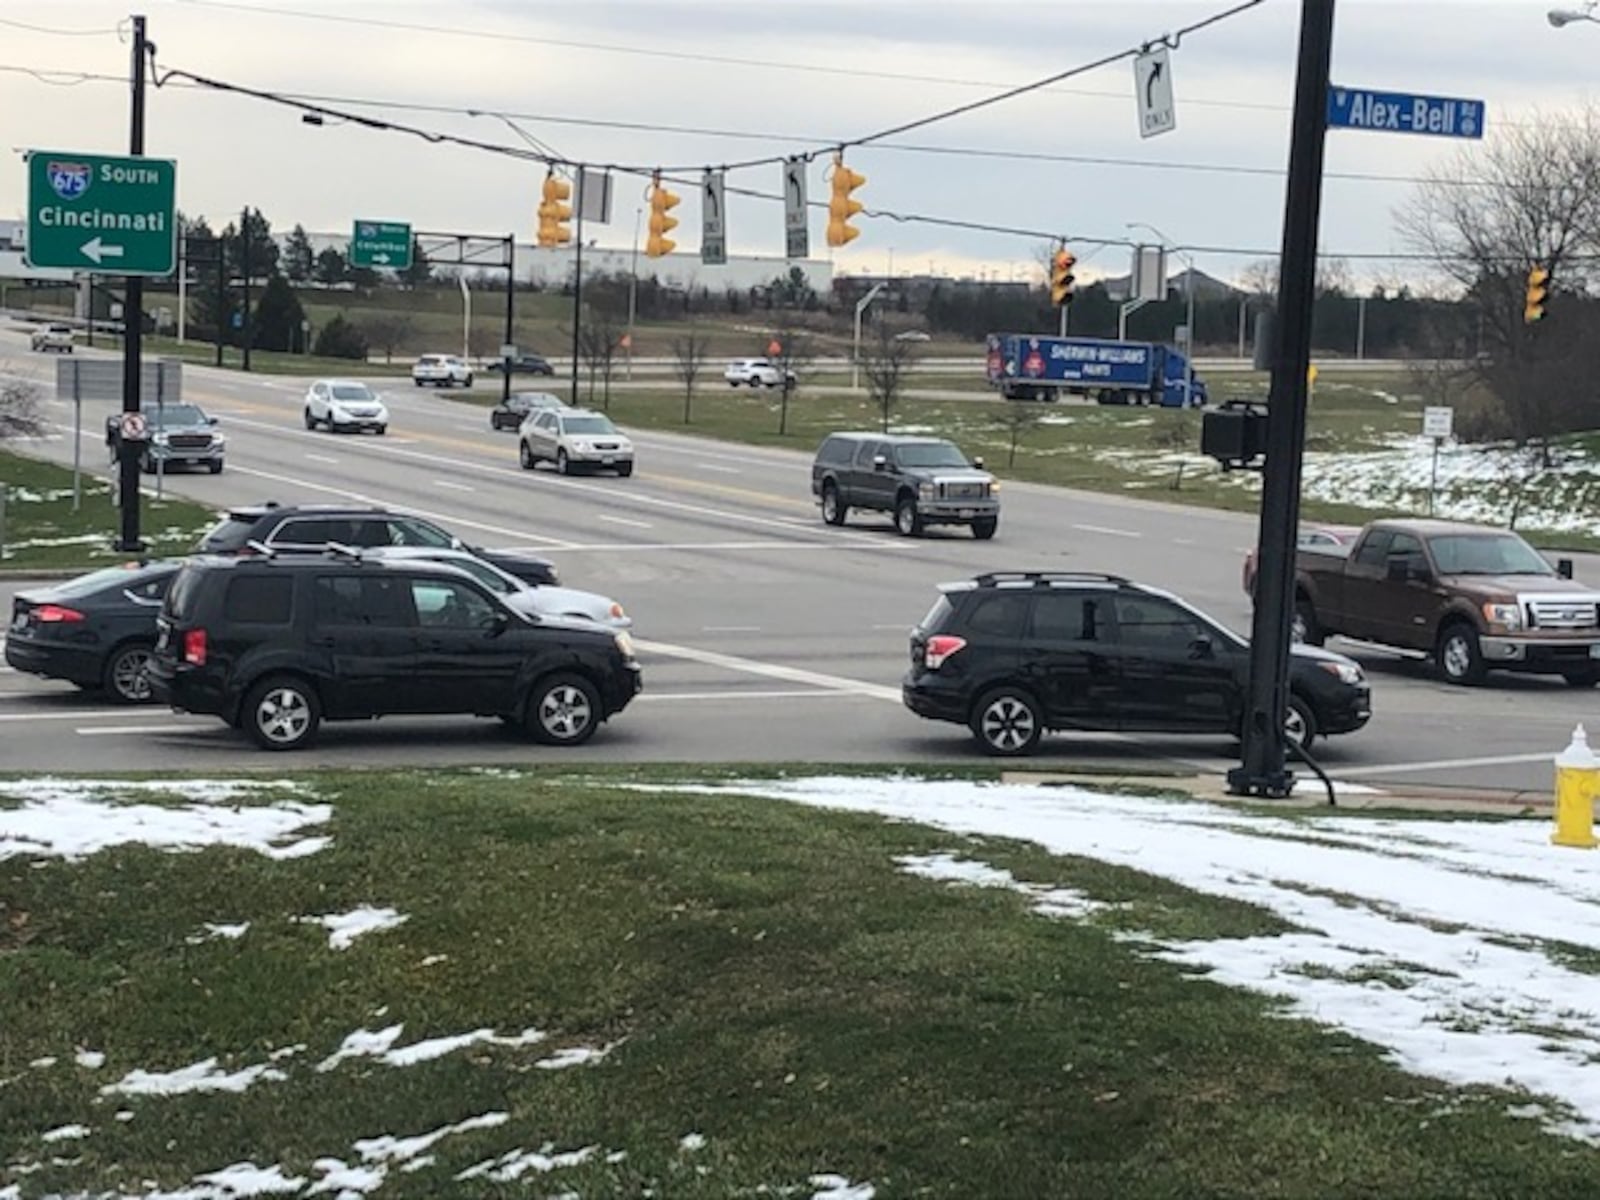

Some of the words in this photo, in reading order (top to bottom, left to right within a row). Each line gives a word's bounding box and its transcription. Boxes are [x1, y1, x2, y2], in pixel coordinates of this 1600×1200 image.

[1349, 93, 1455, 133] Alex-Bell
[53, 172, 87, 191] 675
[38, 206, 165, 232] Cincinnati
